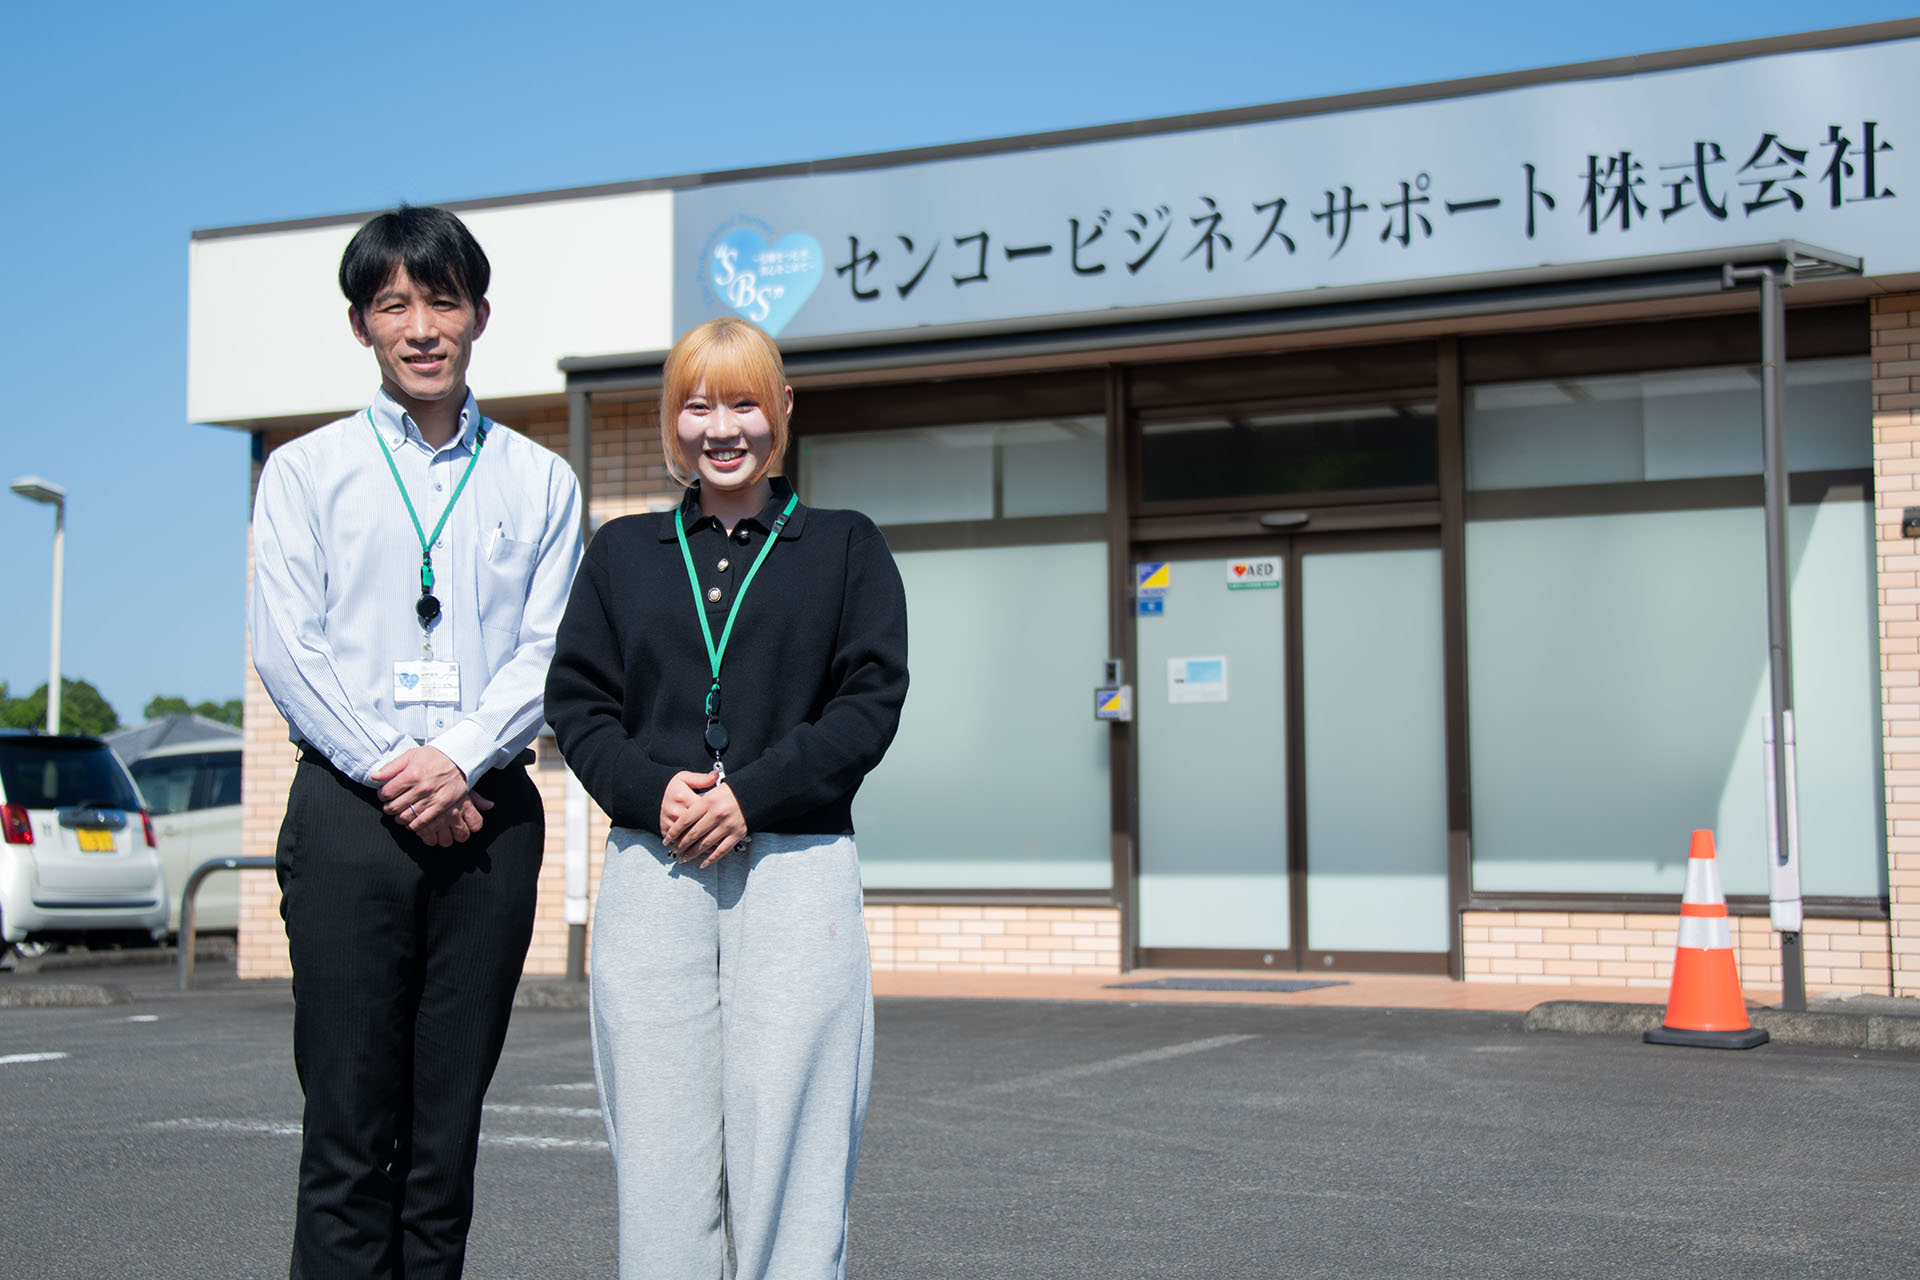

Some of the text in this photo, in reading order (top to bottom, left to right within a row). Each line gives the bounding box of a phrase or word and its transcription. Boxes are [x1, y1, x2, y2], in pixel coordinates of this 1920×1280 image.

[834, 121, 1896, 302] センコービジネスサポート株式会社
[1247, 562, 1273, 576] AED
